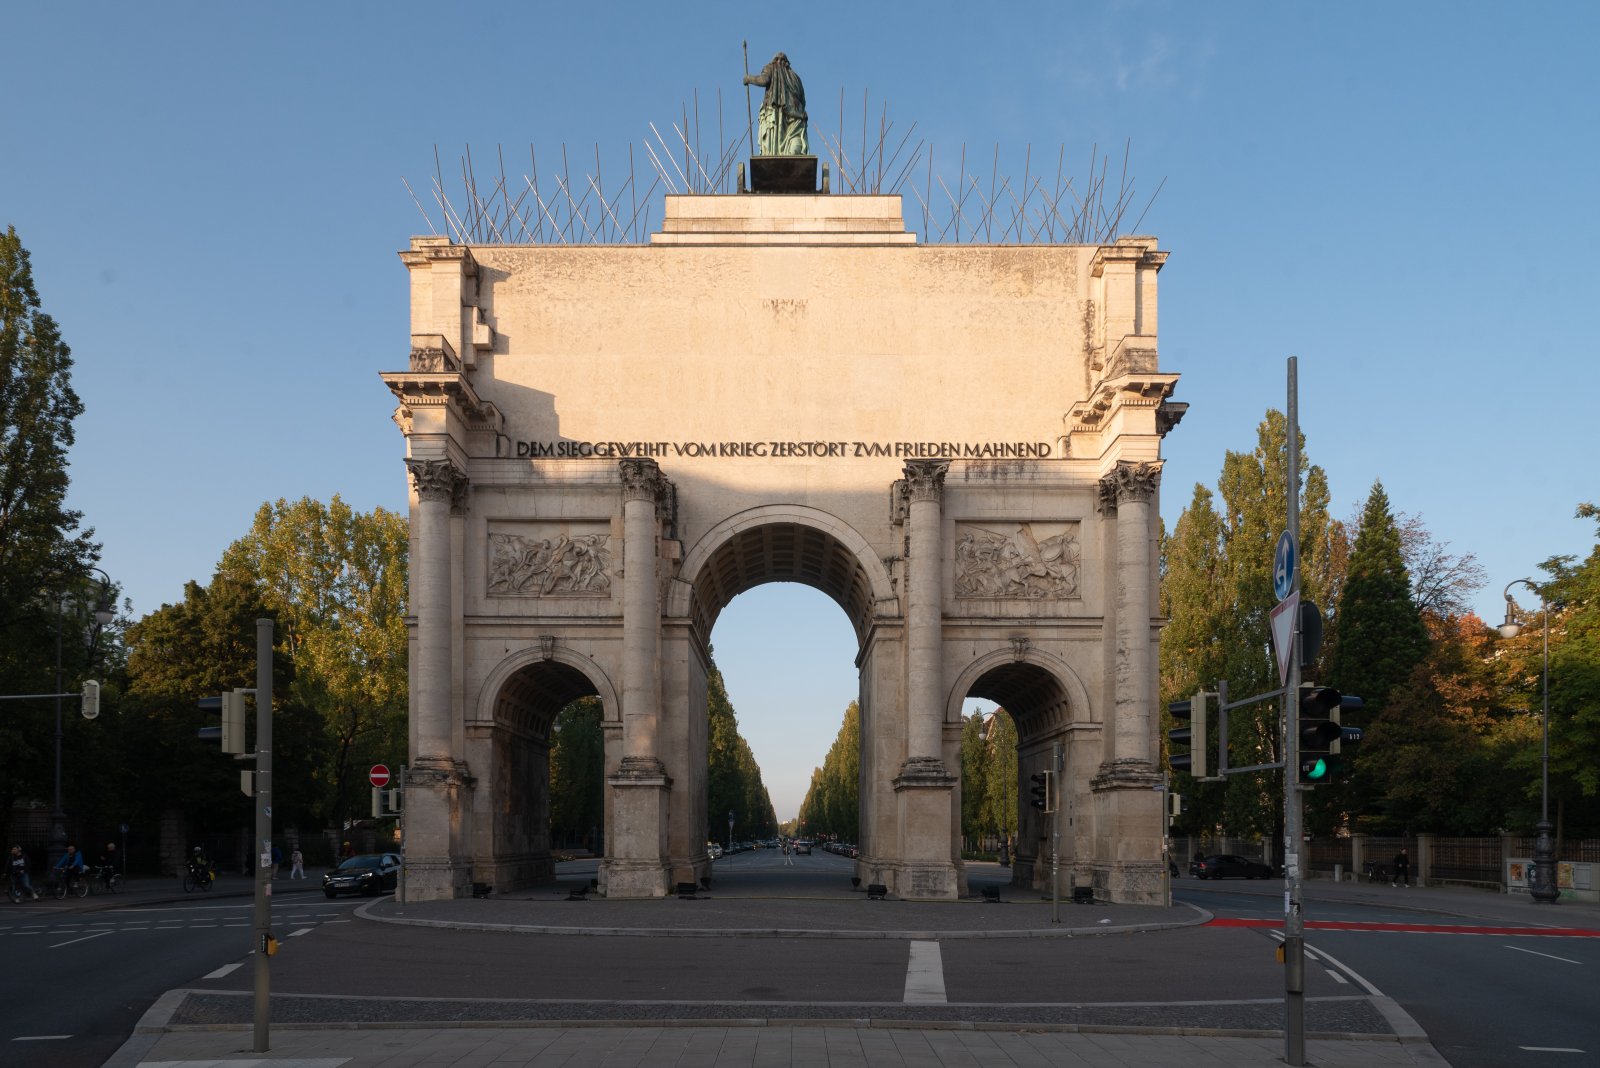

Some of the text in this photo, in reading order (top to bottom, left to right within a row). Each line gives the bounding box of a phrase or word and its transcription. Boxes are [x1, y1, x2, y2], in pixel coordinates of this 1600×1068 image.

[517, 440, 1052, 457] DEM SIEG GEWEIHT VOM KRIEG ZERSTÖRT ZVM FRIEDEN MAHNEND
